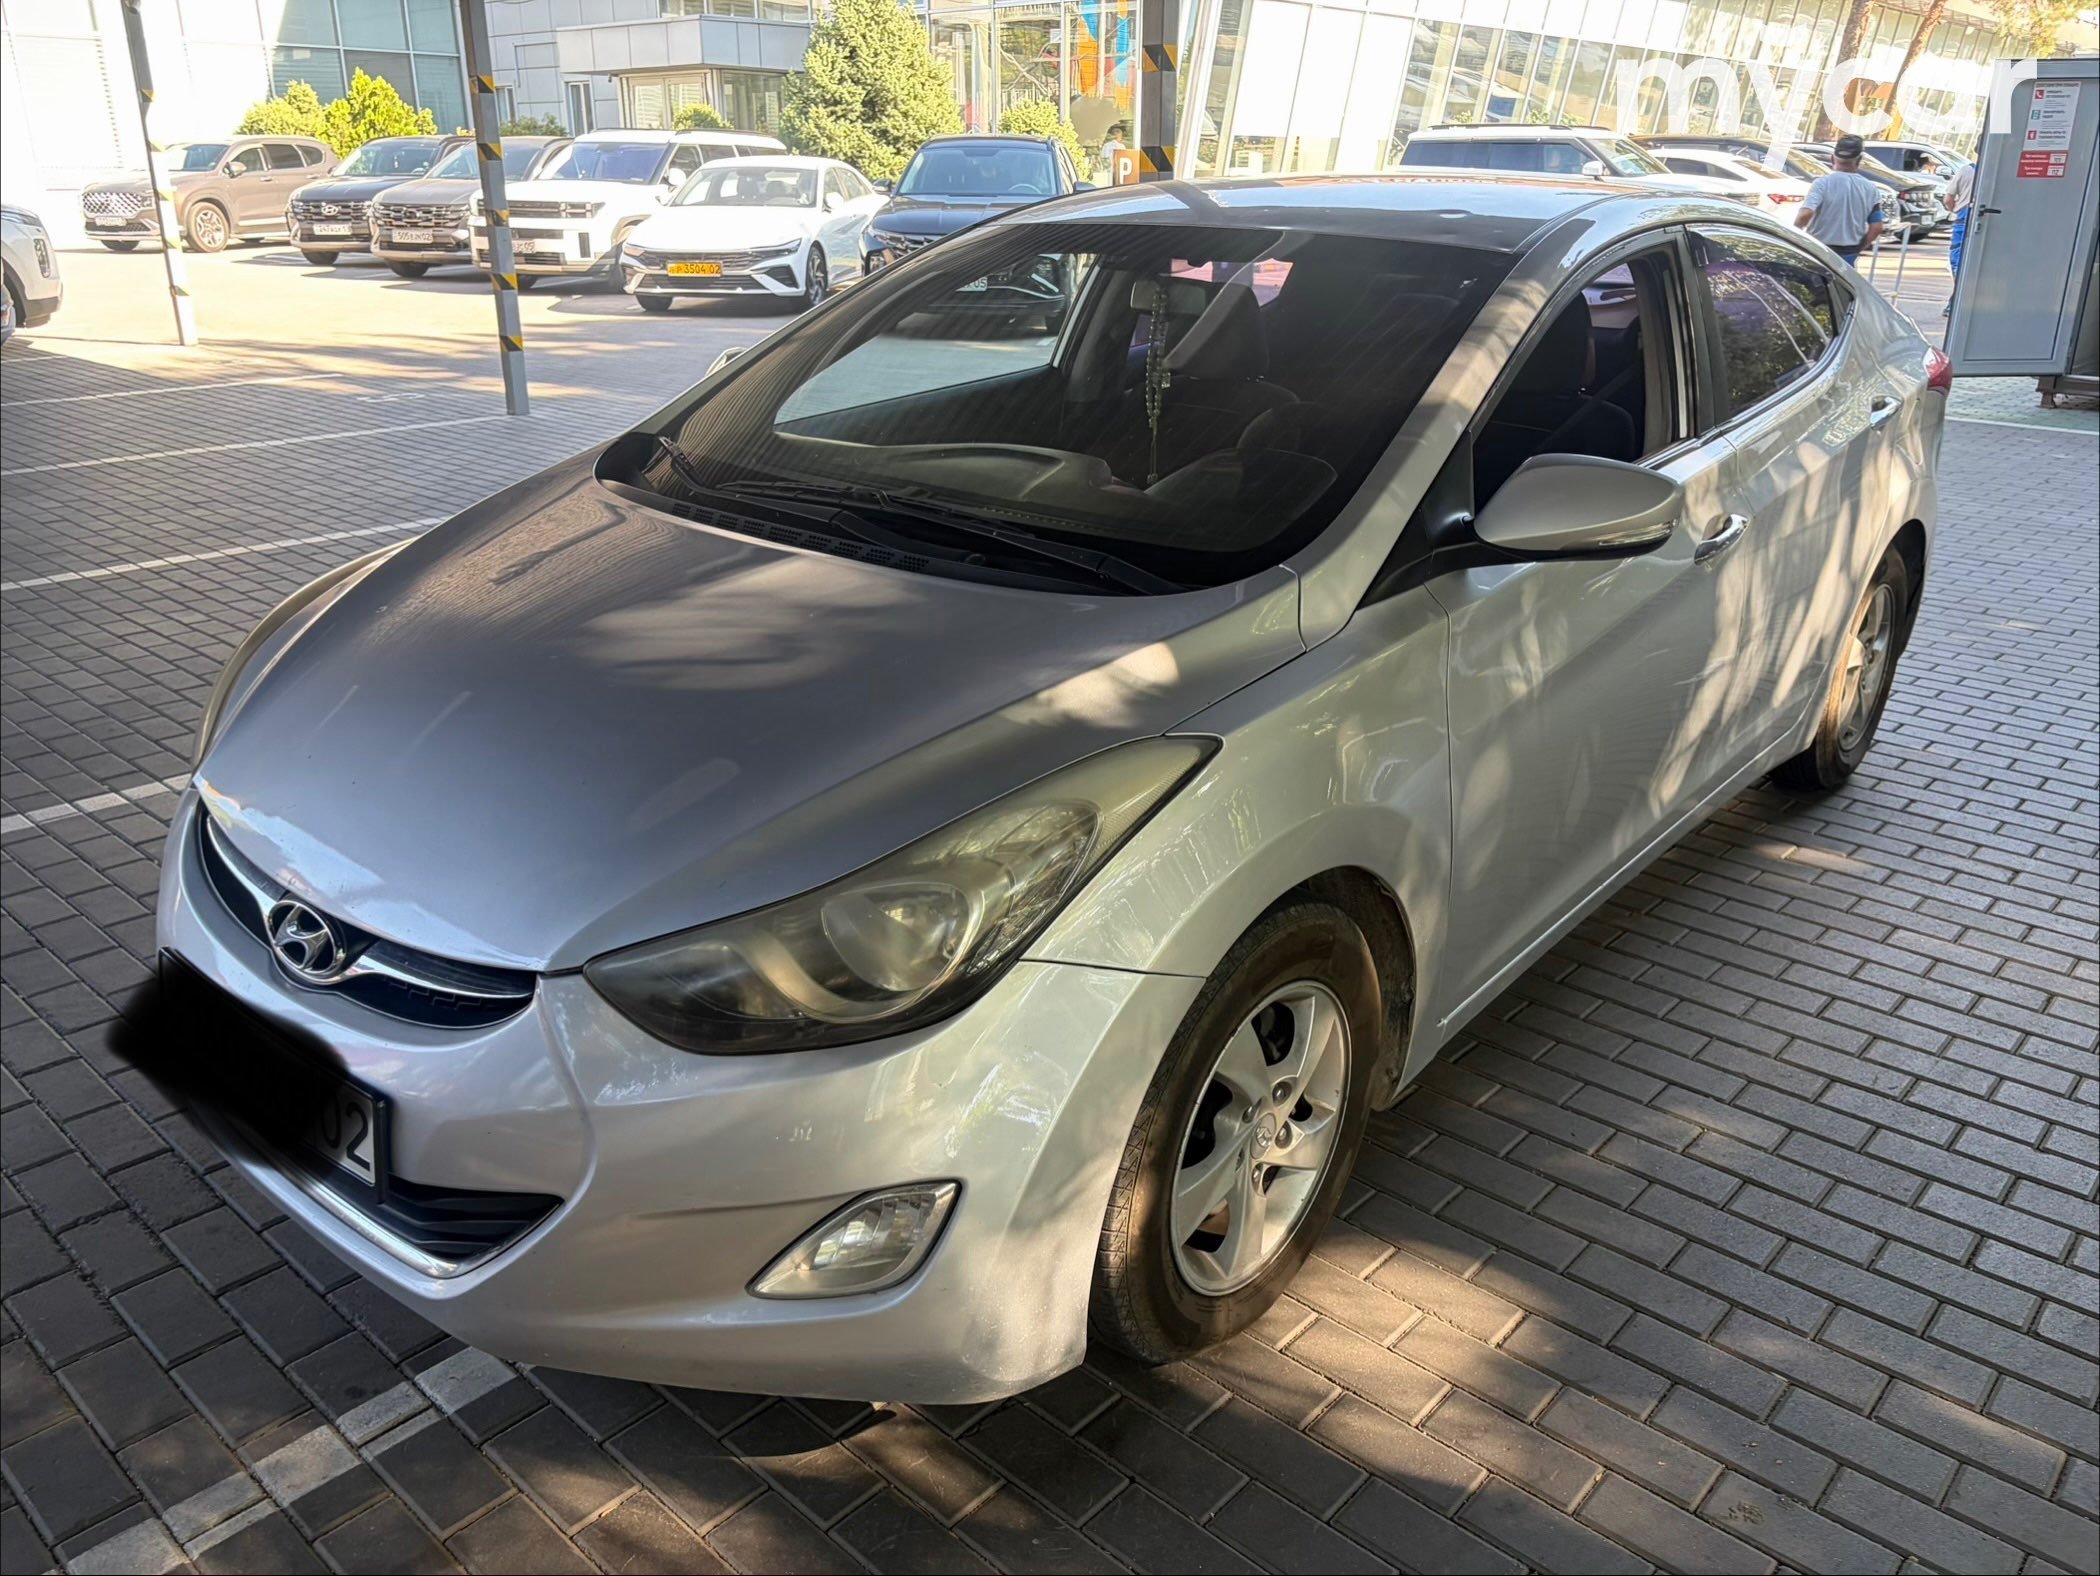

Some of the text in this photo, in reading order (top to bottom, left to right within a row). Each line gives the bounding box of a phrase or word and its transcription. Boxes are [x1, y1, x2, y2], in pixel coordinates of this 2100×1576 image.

[1120, 157, 1132, 184] P
[684, 264, 706, 274] 3504
[709, 264, 721, 274] 02
